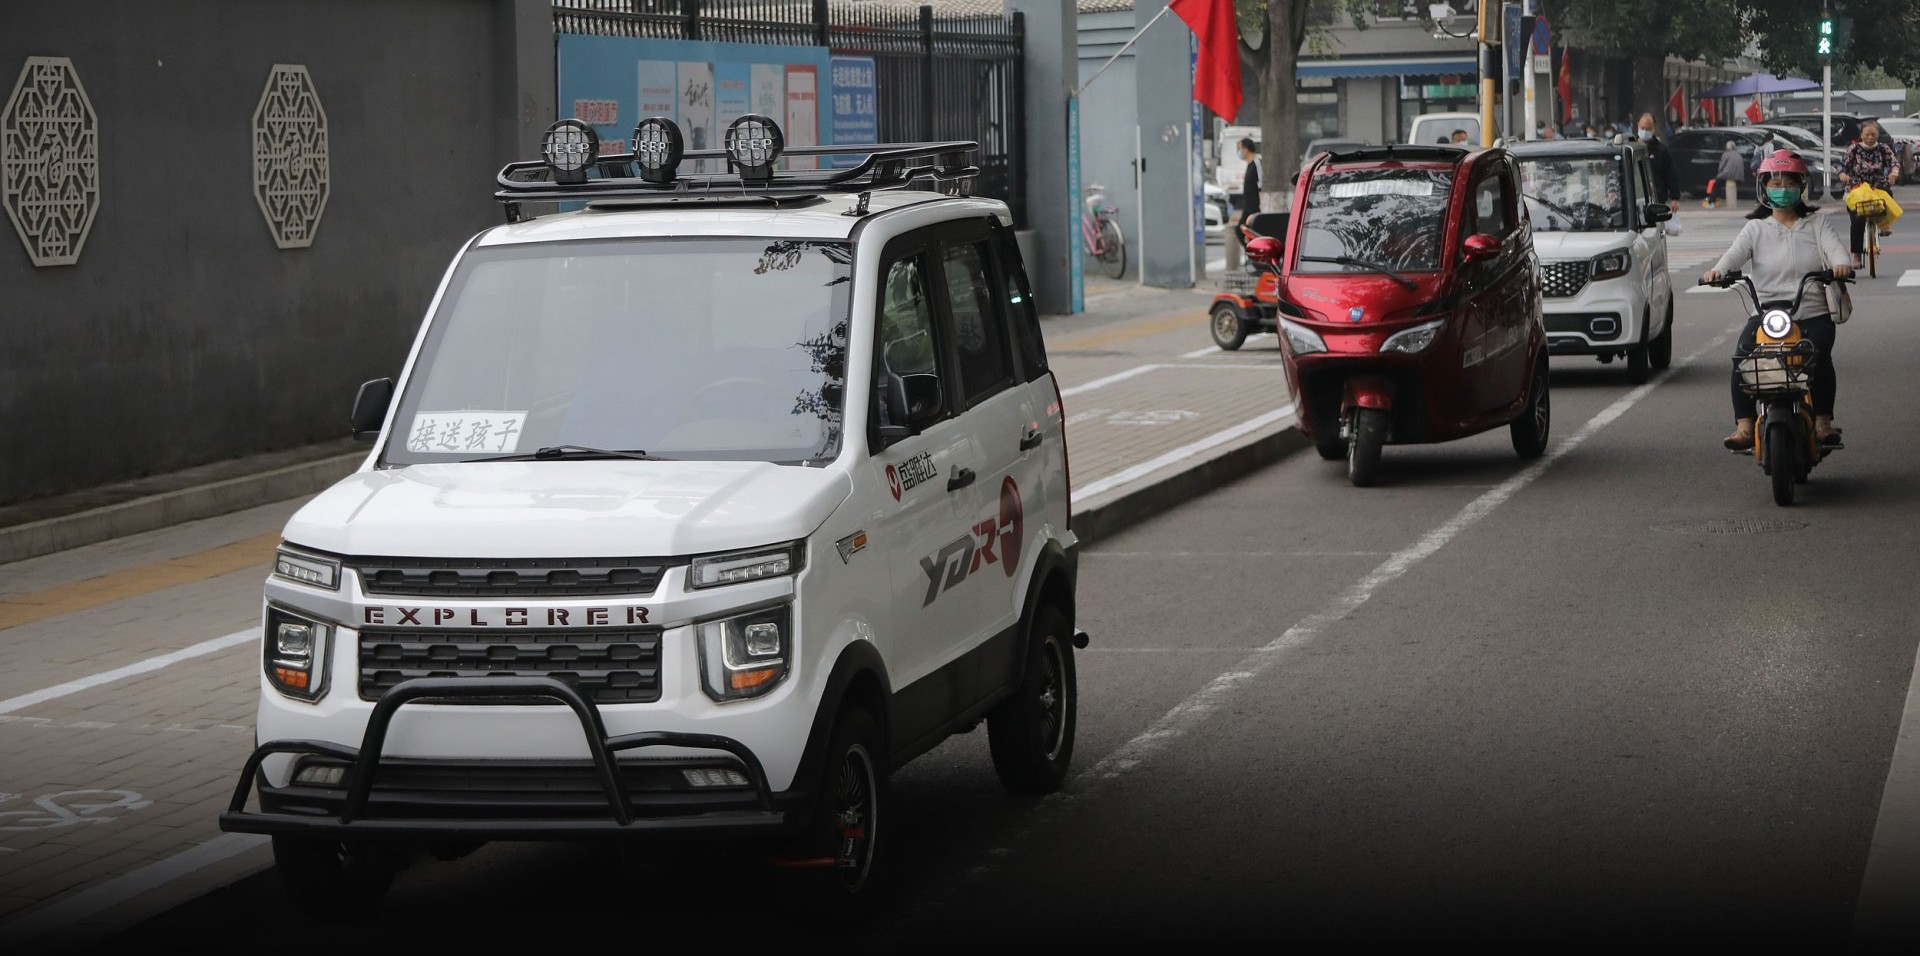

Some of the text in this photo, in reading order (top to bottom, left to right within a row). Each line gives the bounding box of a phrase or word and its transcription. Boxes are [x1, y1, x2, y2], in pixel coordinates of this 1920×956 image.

[1821, 21, 1832, 35] 16
[544, 142, 590, 155] JEEP
[632, 139, 667, 152] JEEP
[728, 138, 773, 151] JEEP
[408, 415, 521, 453] 接送孩子
[898, 451, 938, 491] 盛雅达
[364, 605, 651, 627] EXPLORER
